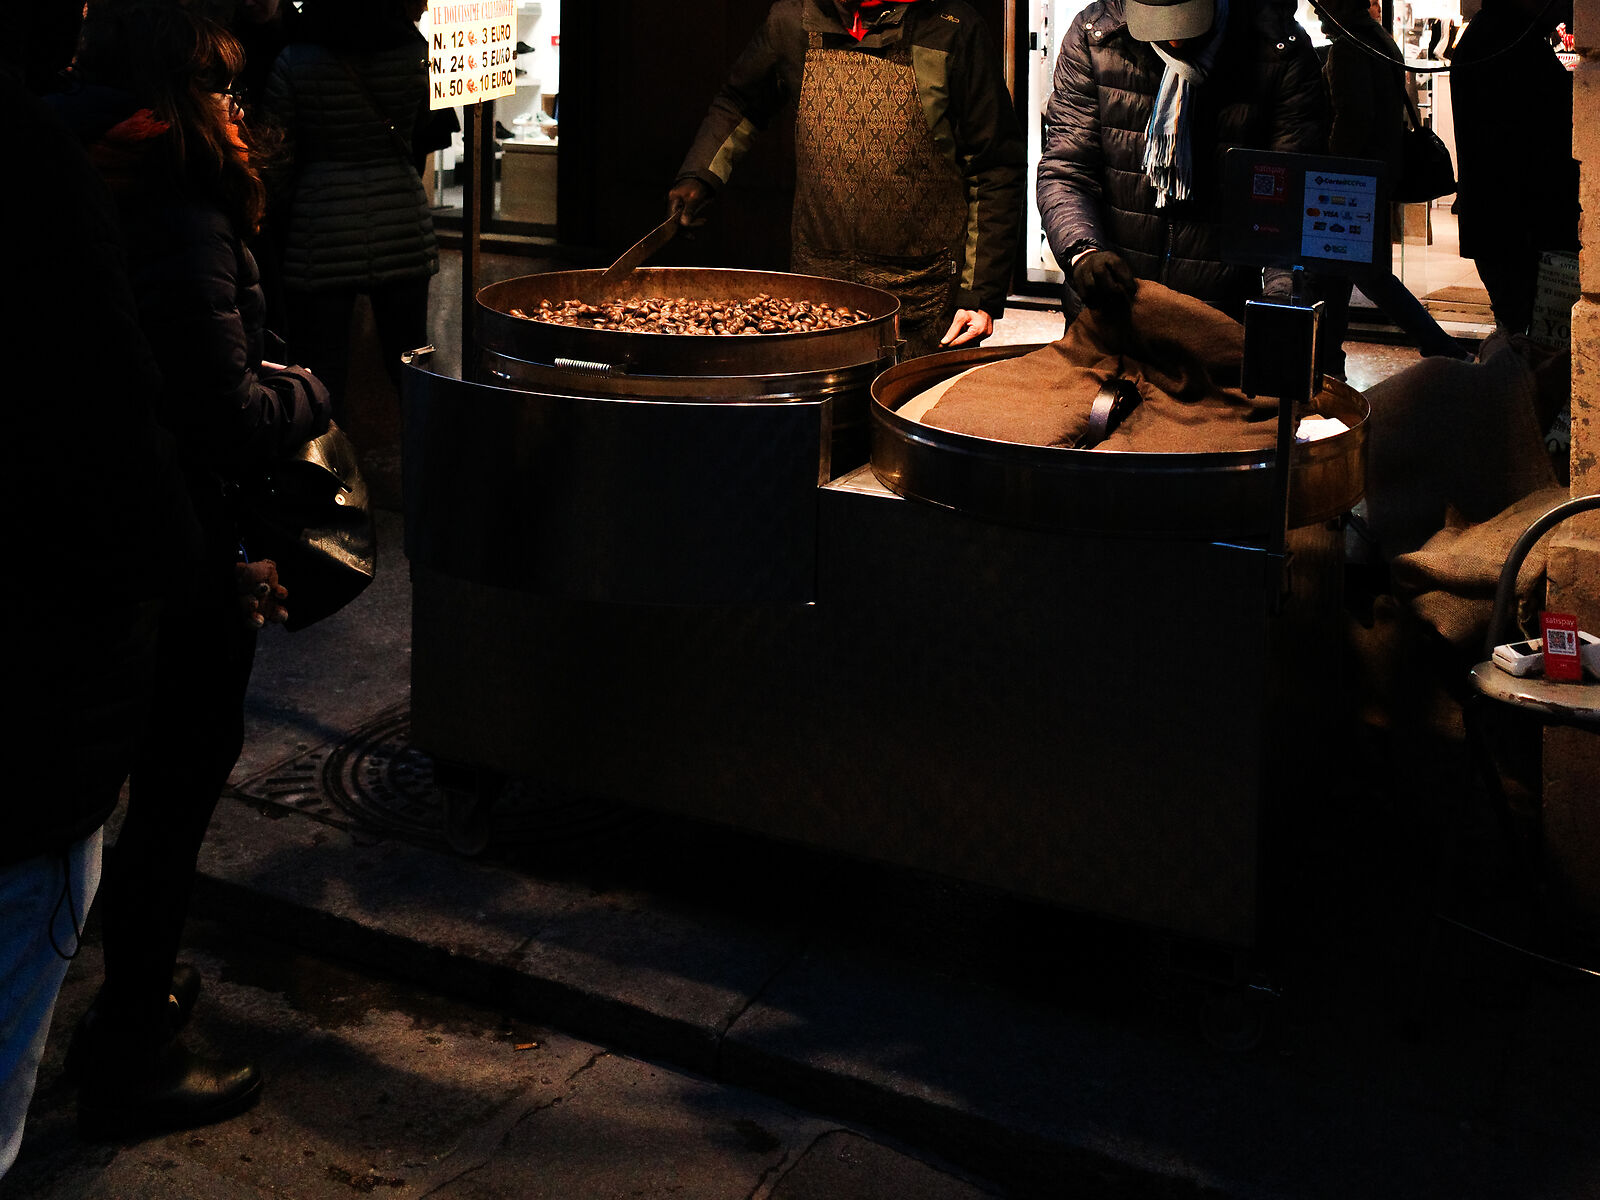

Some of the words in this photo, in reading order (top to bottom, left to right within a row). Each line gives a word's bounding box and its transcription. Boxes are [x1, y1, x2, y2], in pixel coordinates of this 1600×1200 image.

[433, 6, 441, 25] LE
[444, 2, 480, 24] DOLCISSIME
[434, 32, 446, 50] N.
[451, 30, 464, 48] 12
[482, 27, 488, 44] 3
[491, 24, 511, 43] EURO
[433, 57, 445, 75] N.
[450, 55, 464, 73] 24
[482, 51, 488, 68] 5
[491, 47, 511, 66] EURO
[434, 81, 446, 99] N.
[449, 79, 463, 97] 50
[480, 74, 490, 91] 10
[491, 69, 513, 89] EURO
